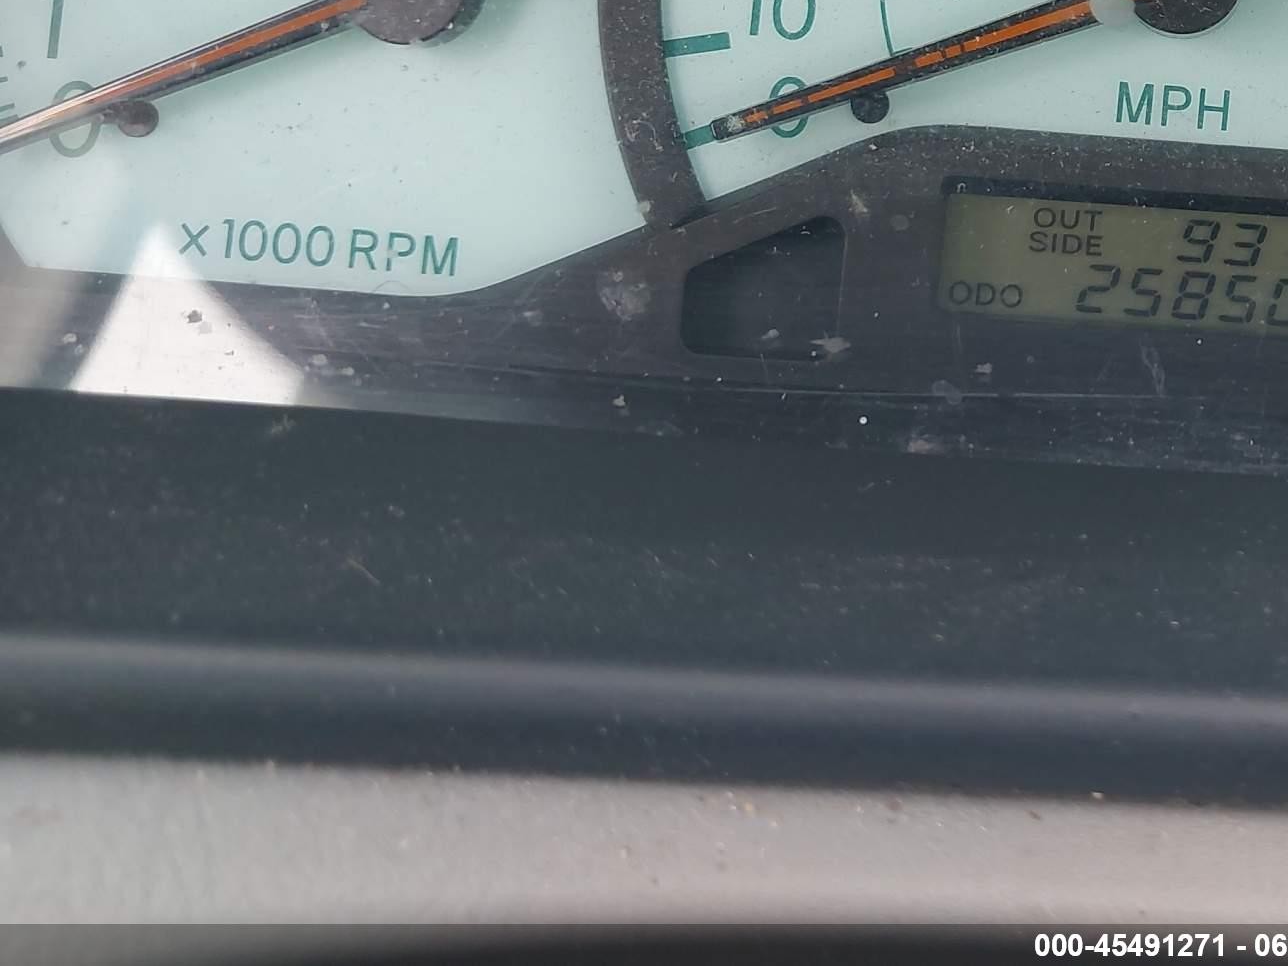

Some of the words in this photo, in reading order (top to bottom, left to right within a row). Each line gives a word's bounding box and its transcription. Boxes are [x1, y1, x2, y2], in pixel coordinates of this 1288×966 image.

[768, 76, 808, 138] 0
[1115, 81, 1230, 131] MPH
[1033, 206, 1103, 232] OUT
[1176, 219, 1268, 267] 93
[347, 228, 459, 276] RPM
[1028, 232, 1103, 257] SIDE
[948, 280, 1024, 309] ODO
